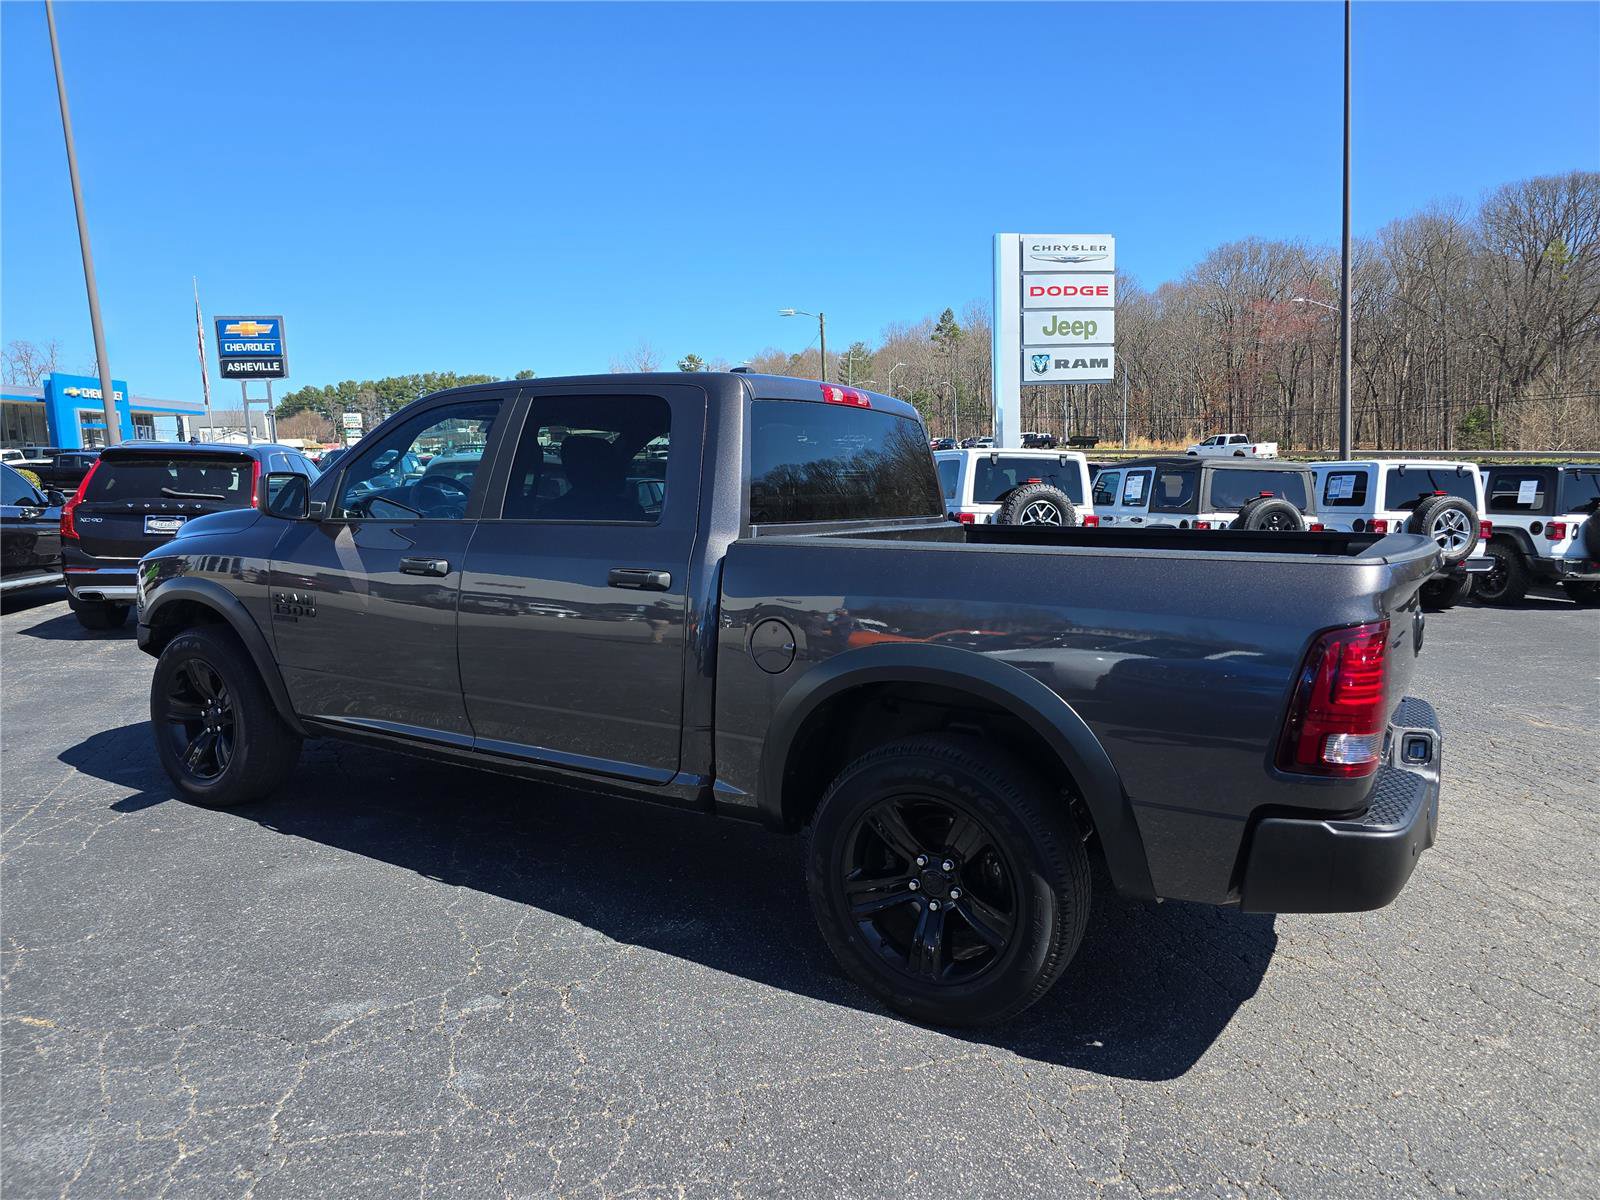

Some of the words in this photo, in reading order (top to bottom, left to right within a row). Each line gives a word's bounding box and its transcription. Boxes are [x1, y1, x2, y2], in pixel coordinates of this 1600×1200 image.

[1032, 244, 1107, 252] CHRYSLER
[1030, 285, 1109, 297] DODGE
[1042, 315, 1098, 340] Jeep
[224, 342, 276, 352] CHEVROLET
[227, 362, 281, 372] ASHEVILLE
[1054, 358, 1109, 370] RAM
[81, 387, 123, 401] CHEVET
